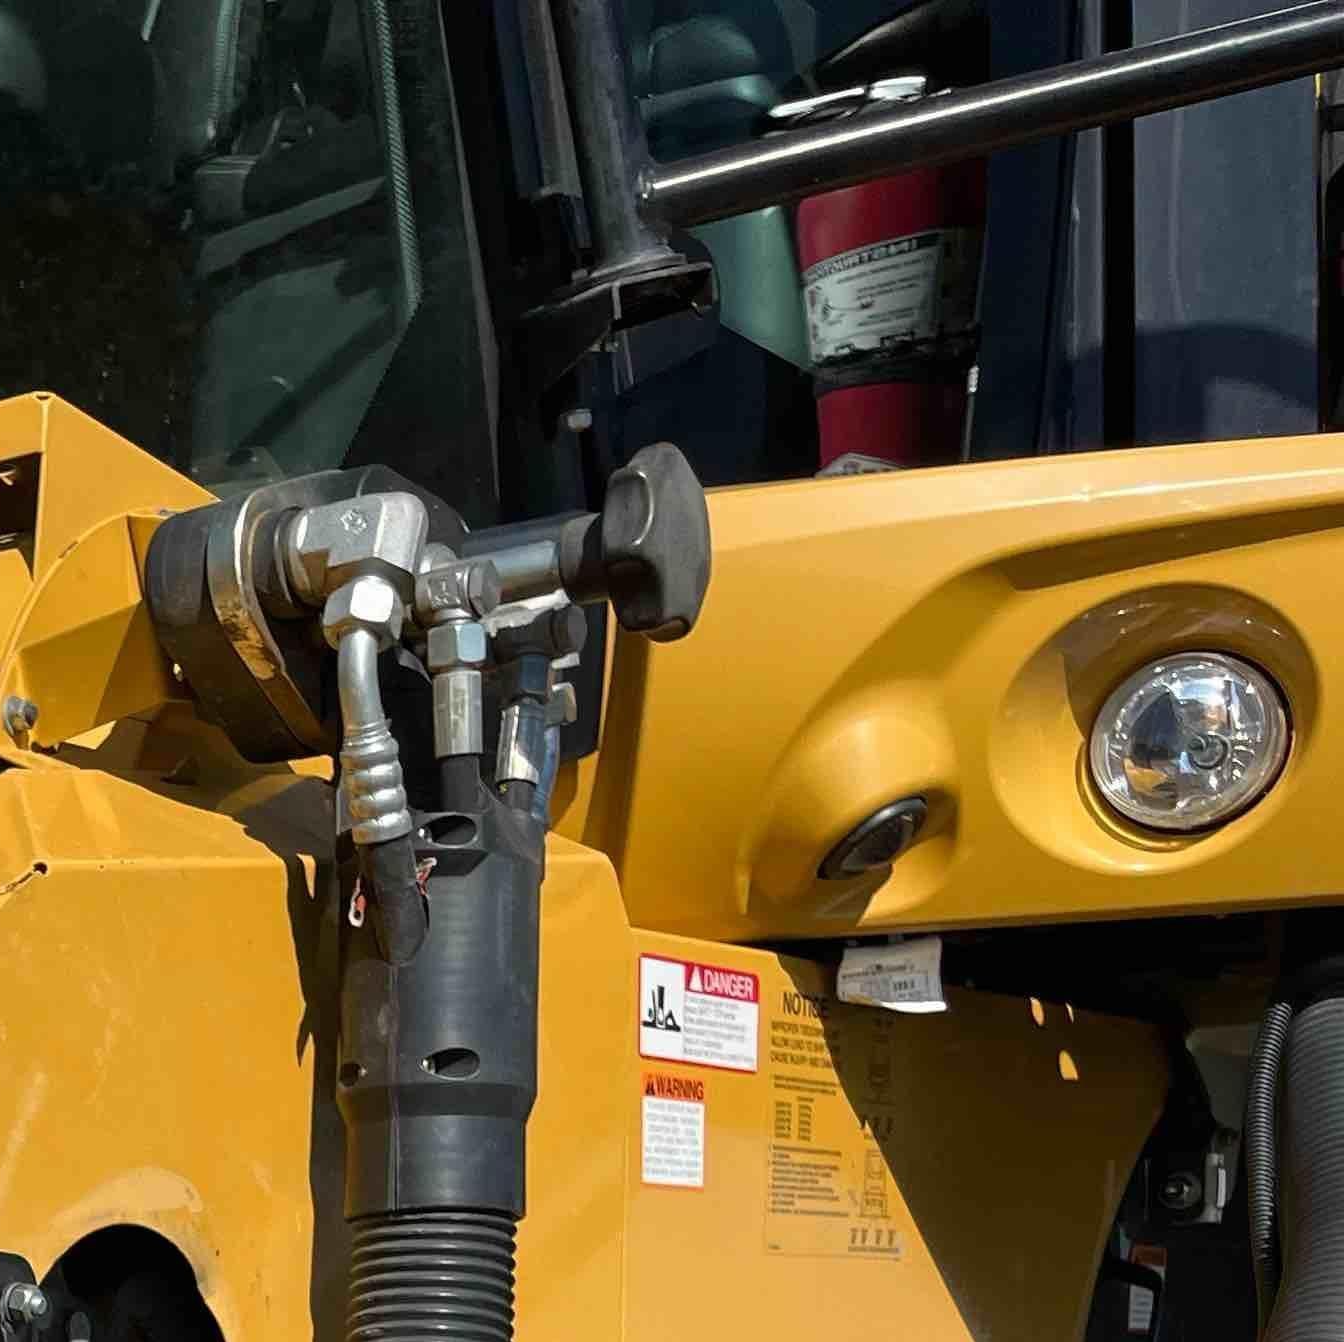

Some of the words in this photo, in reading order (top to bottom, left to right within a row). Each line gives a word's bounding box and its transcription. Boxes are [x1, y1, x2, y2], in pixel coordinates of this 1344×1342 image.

[703, 969, 754, 1000] DANGER
[783, 991, 830, 1019] NOTICE
[655, 1074, 704, 1100] WARNING
